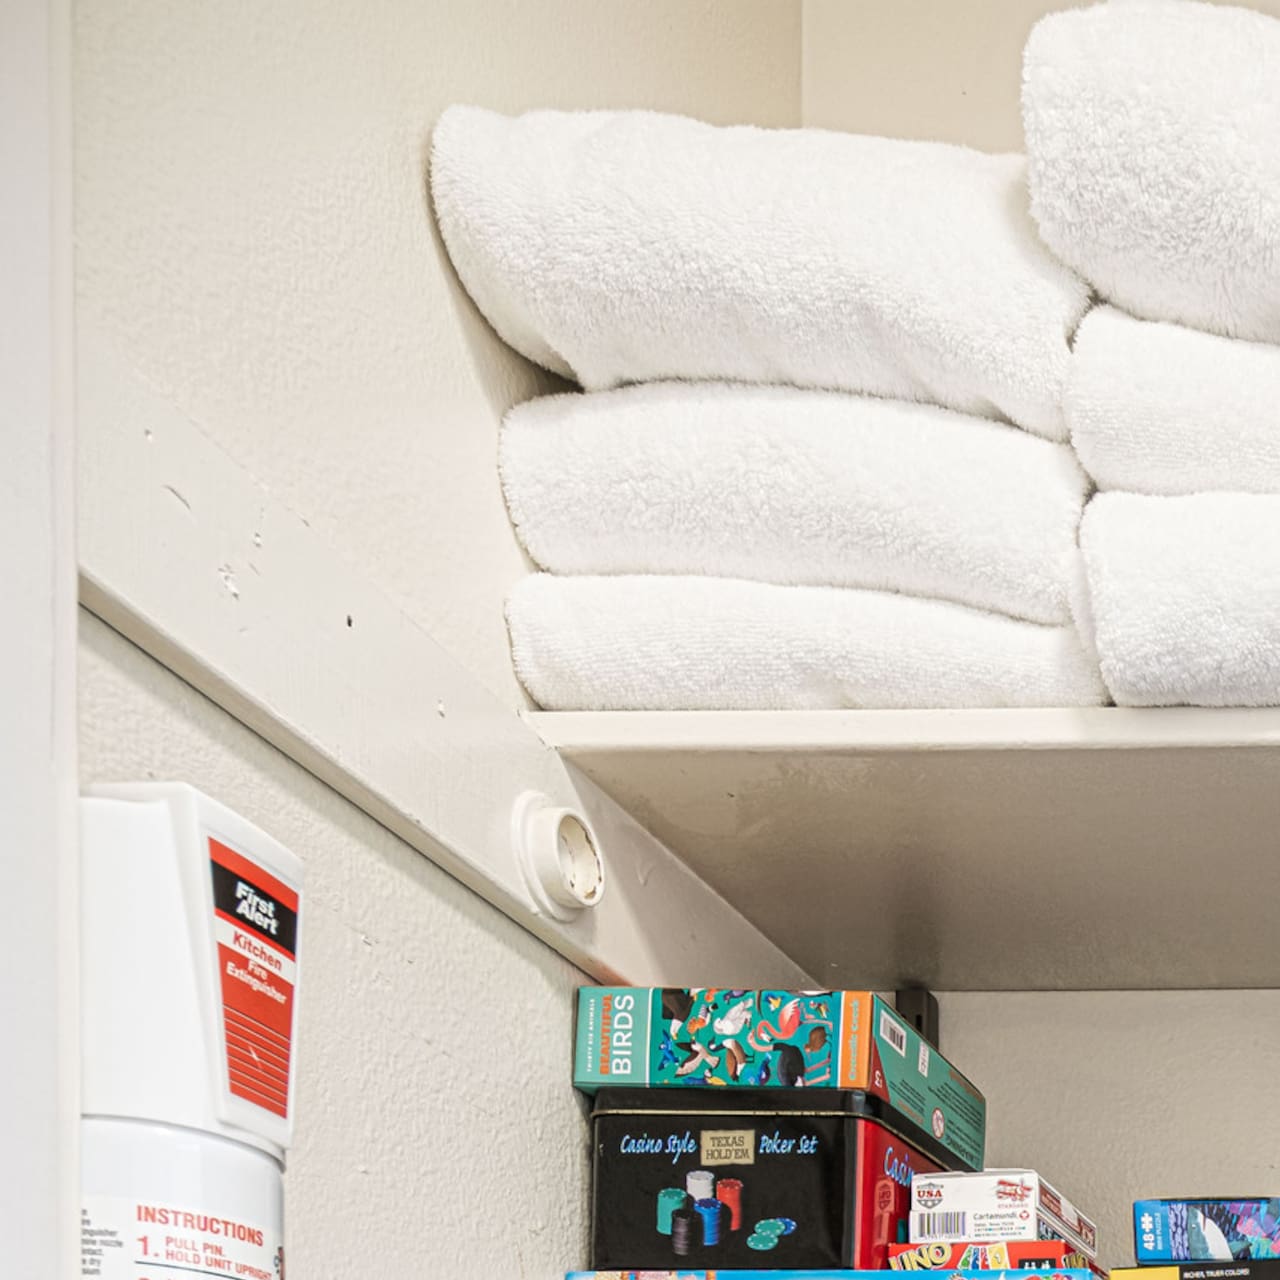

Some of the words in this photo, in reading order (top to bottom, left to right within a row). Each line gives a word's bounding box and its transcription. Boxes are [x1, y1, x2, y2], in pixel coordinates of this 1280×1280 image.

[235, 881, 274, 917] First
[236, 899, 278, 935] Alert
[233, 931, 282, 970] Kitchen
[226, 961, 286, 1004] Extinguisher
[248, 961, 267, 980] Fire
[600, 993, 613, 1074] BEAUTIFUL
[612, 995, 634, 1074] BIRDS
[620, 1133, 662, 1153] Casino
[665, 1131, 697, 1164] Style
[710, 1136, 744, 1147] TEXAS
[759, 1131, 795, 1154] Poker
[797, 1135, 818, 1154] Set
[706, 1149, 750, 1160] HOLD'EM
[917, 1190, 942, 1198] USA
[137, 1205, 263, 1247] INSTRUCTIONS
[137, 1236, 159, 1257] 1.
[166, 1236, 198, 1252] PULL
[202, 1242, 226, 1257] PIN.
[1143, 1234, 1155, 1250] 48
[166, 1250, 201, 1265] HOLD
[205, 1256, 232, 1271] UNIT
[889, 1242, 952, 1270] UNO
